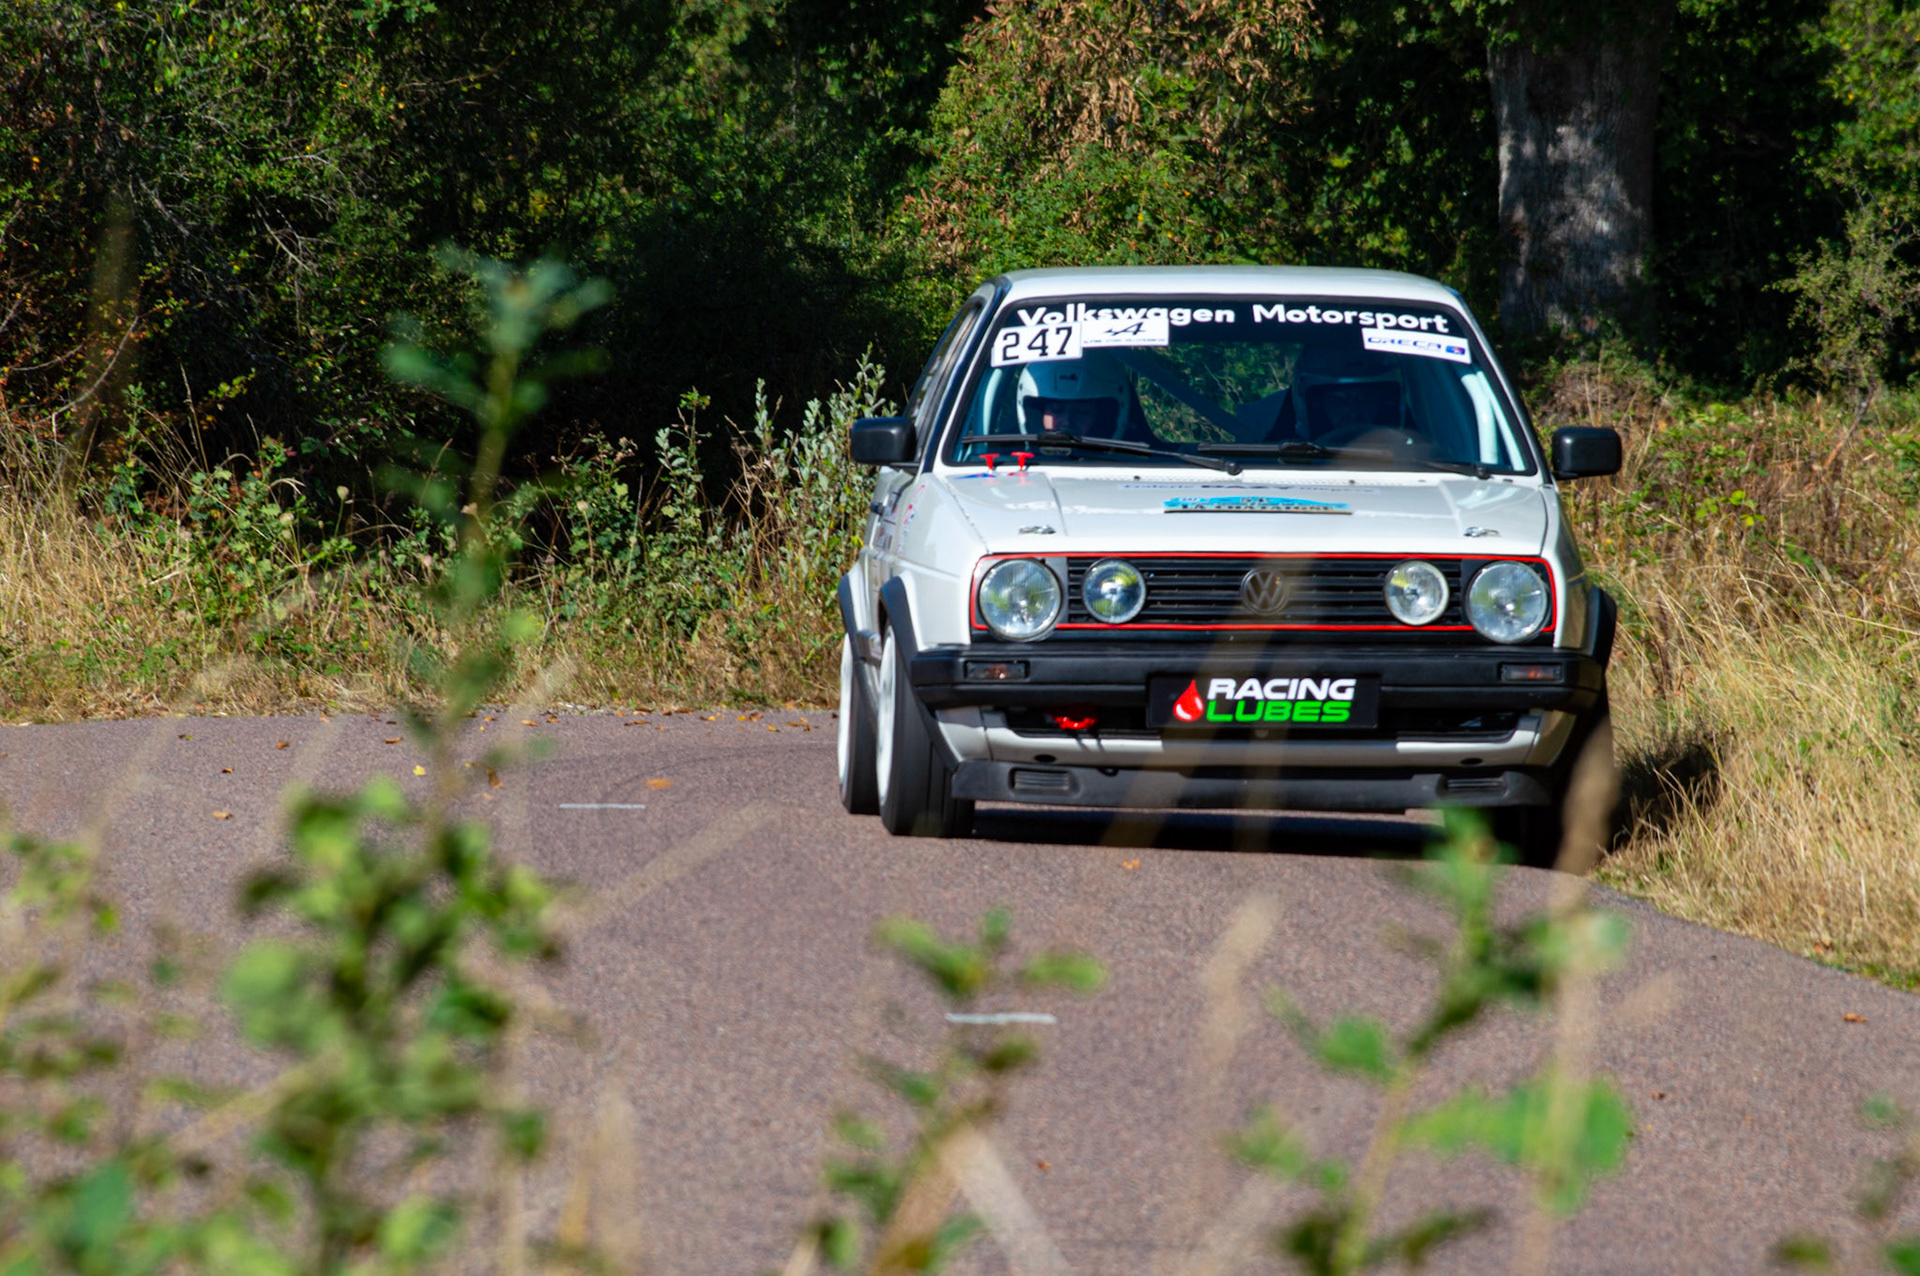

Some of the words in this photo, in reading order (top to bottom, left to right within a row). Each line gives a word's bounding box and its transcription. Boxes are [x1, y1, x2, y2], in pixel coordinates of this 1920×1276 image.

[1017, 302, 1236, 327] Volkswagen
[1252, 303, 1450, 333] Motorsport
[1002, 326, 1074, 362] 247
[1206, 677, 1358, 701] RACING
[1206, 700, 1353, 723] LUBES
